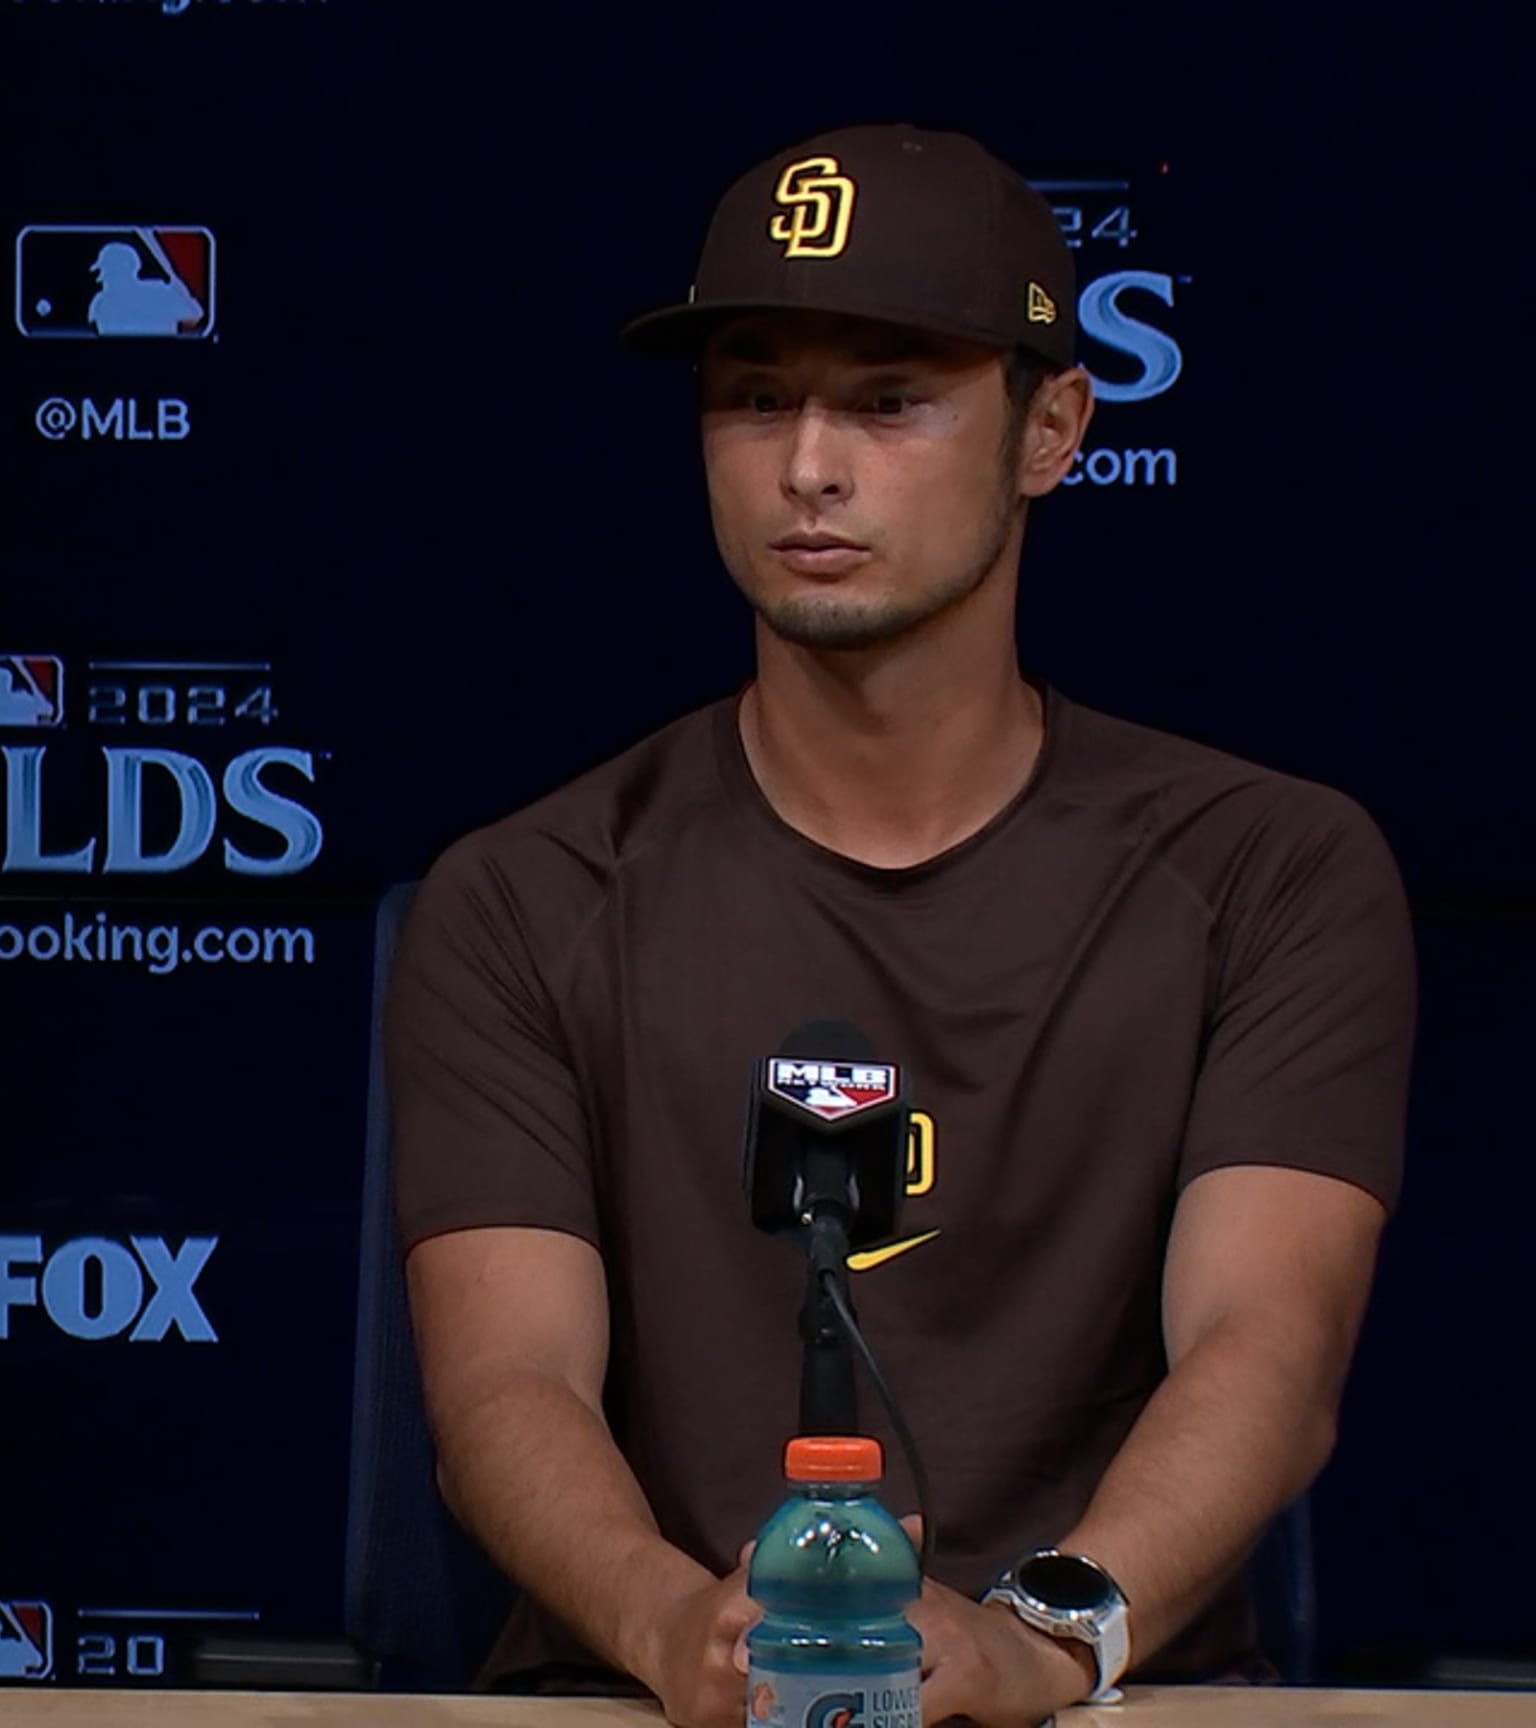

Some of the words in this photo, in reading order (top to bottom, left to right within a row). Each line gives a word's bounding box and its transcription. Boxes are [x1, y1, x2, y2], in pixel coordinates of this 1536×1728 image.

[768, 154, 858, 259] SD
[34, 395, 192, 442] @MLB
[87, 685, 280, 727] 2024
[777, 1063, 888, 1083] MLB
